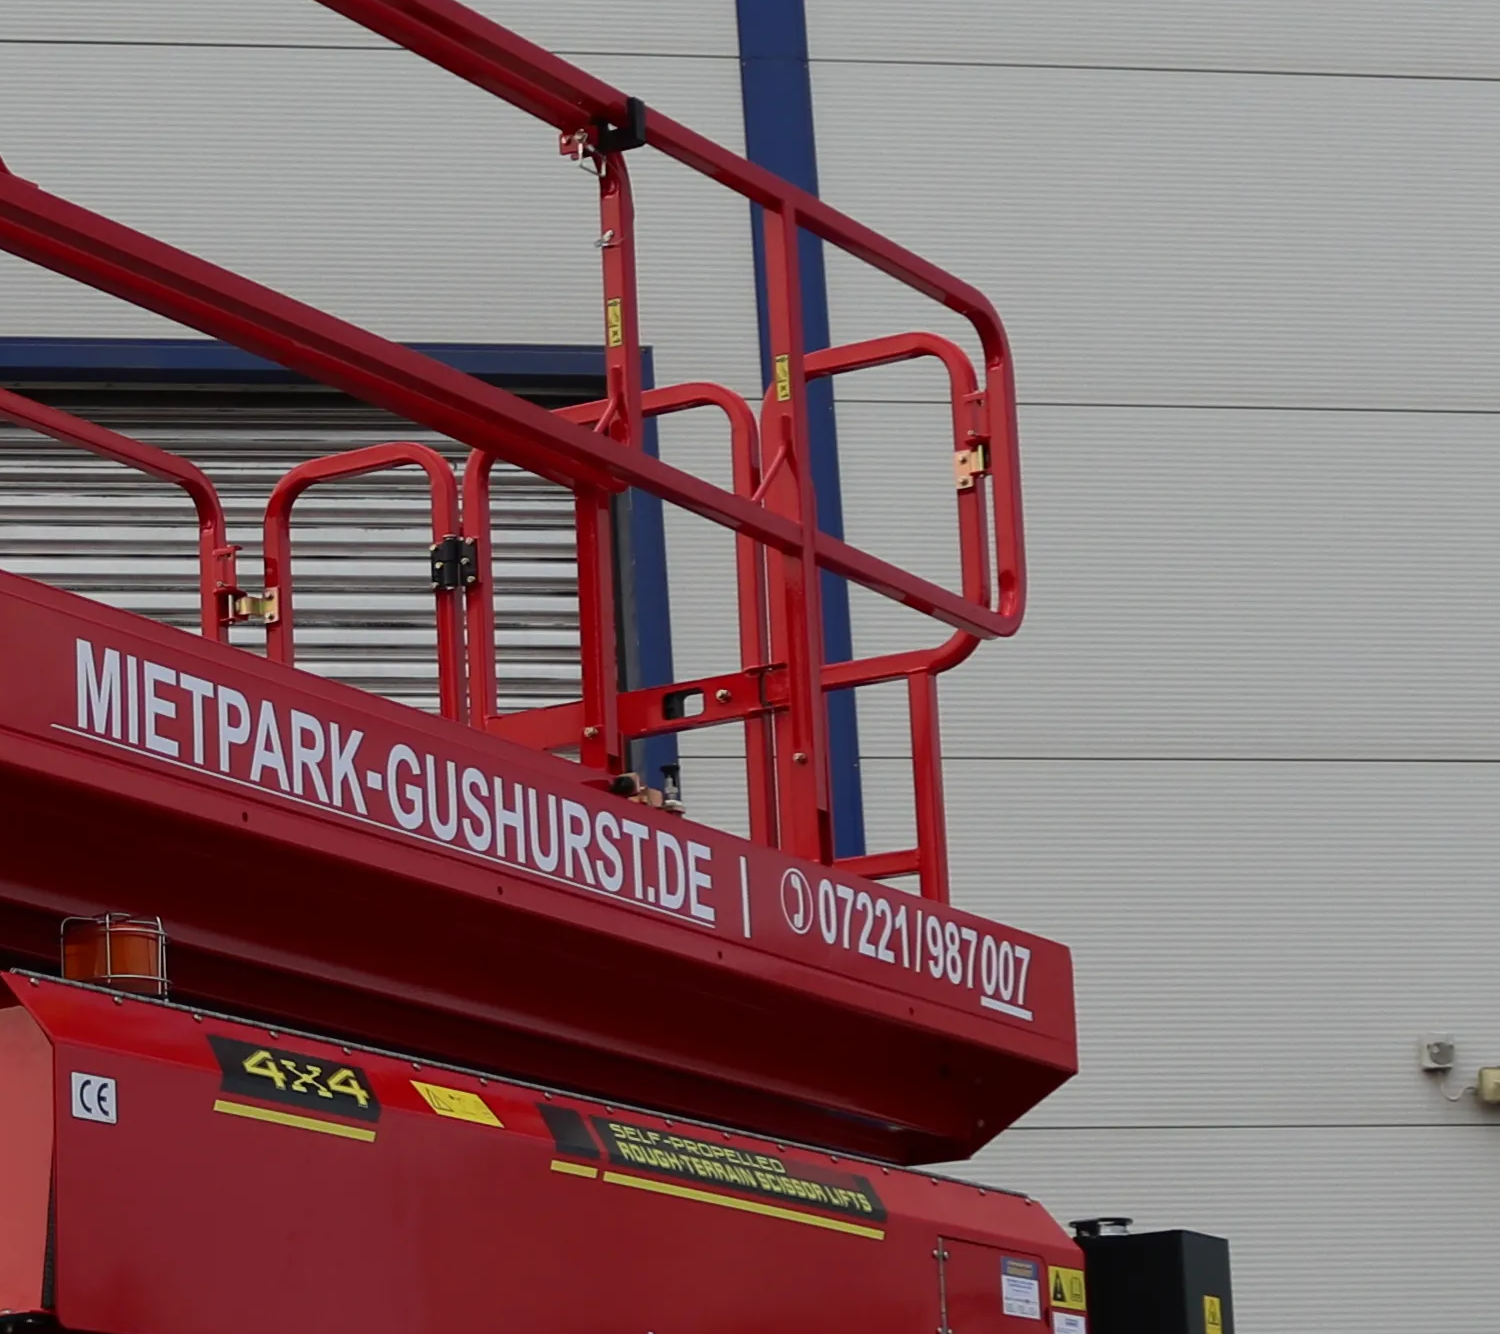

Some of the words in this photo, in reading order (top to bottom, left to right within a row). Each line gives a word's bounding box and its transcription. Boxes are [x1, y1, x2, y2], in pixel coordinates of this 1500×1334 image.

[76, 637, 715, 922] MIETPARK-GUSHURST.DE
[758, 1170, 828, 1203] SCISSOR
[826, 1186, 873, 1213] LIFTS
